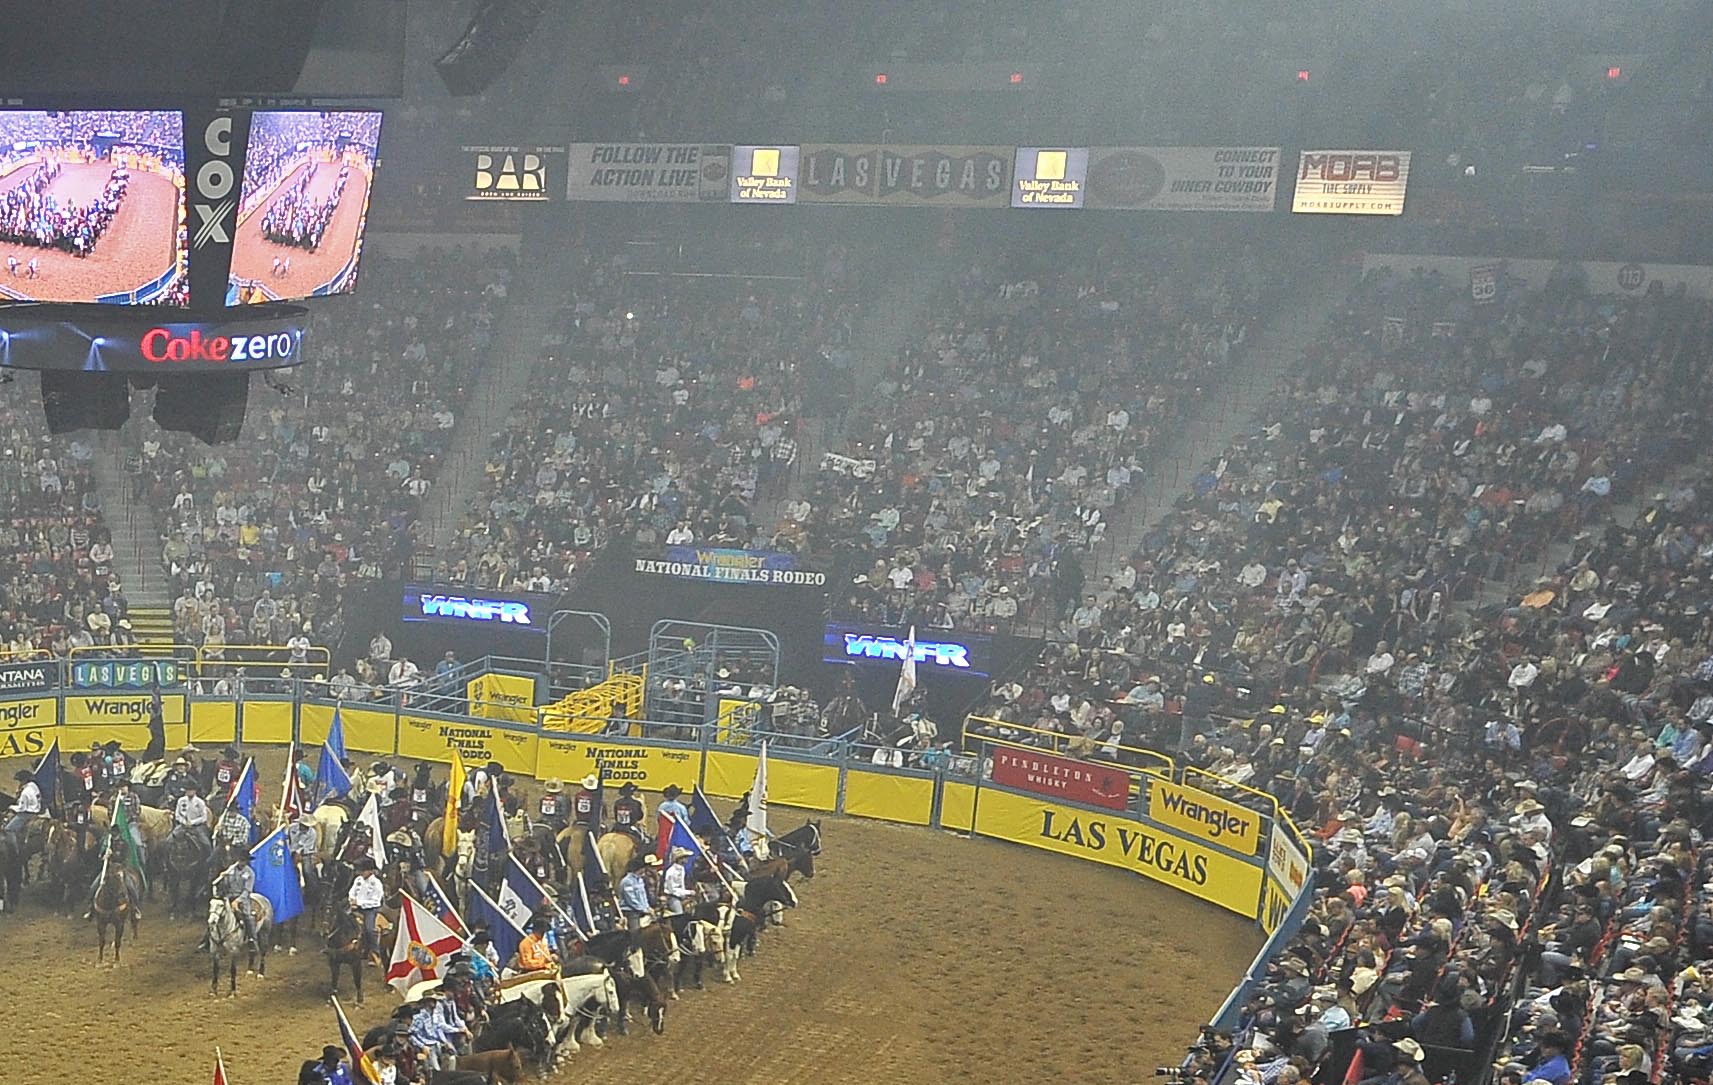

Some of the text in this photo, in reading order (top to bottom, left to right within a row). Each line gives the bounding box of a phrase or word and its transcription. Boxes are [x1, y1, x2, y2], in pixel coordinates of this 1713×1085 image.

[591, 147, 699, 164] FOLLOW THE
[1214, 151, 1277, 163] CONNECT
[808, 158, 1001, 190] LAS VEGAS
[1218, 166, 1272, 177] TO YOUR
[1301, 155, 1399, 182] MOAB
[194, 118, 235, 249] COX
[591, 169, 699, 186] ACTION LIVE
[737, 177, 791, 189] Valley Bank
[740, 188, 786, 198] of Nevada
[1019, 180, 1079, 193] Valley Bank
[1216, 181, 1272, 193] COWBOY
[1023, 191, 1073, 203] of Nevada
[140, 328, 292, 362] Coke zero
[635, 559, 826, 586] NATIONAL FINALS RODEO
[421, 594, 531, 624] WNFR
[77, 666, 110, 681] LAS
[490, 690, 529, 705] Wrangler
[439, 726, 493, 740] NATIONAL
[586, 747, 649, 760] NATIONAL
[594, 758, 639, 770] FINALS
[1001, 754, 1093, 783] PENDLETON
[601, 768, 647, 781] RODEO
[1027, 773, 1068, 790] WHISKY
[1161, 786, 1250, 838] Wrangler
[1040, 810, 1208, 886] LAS VEGAS
